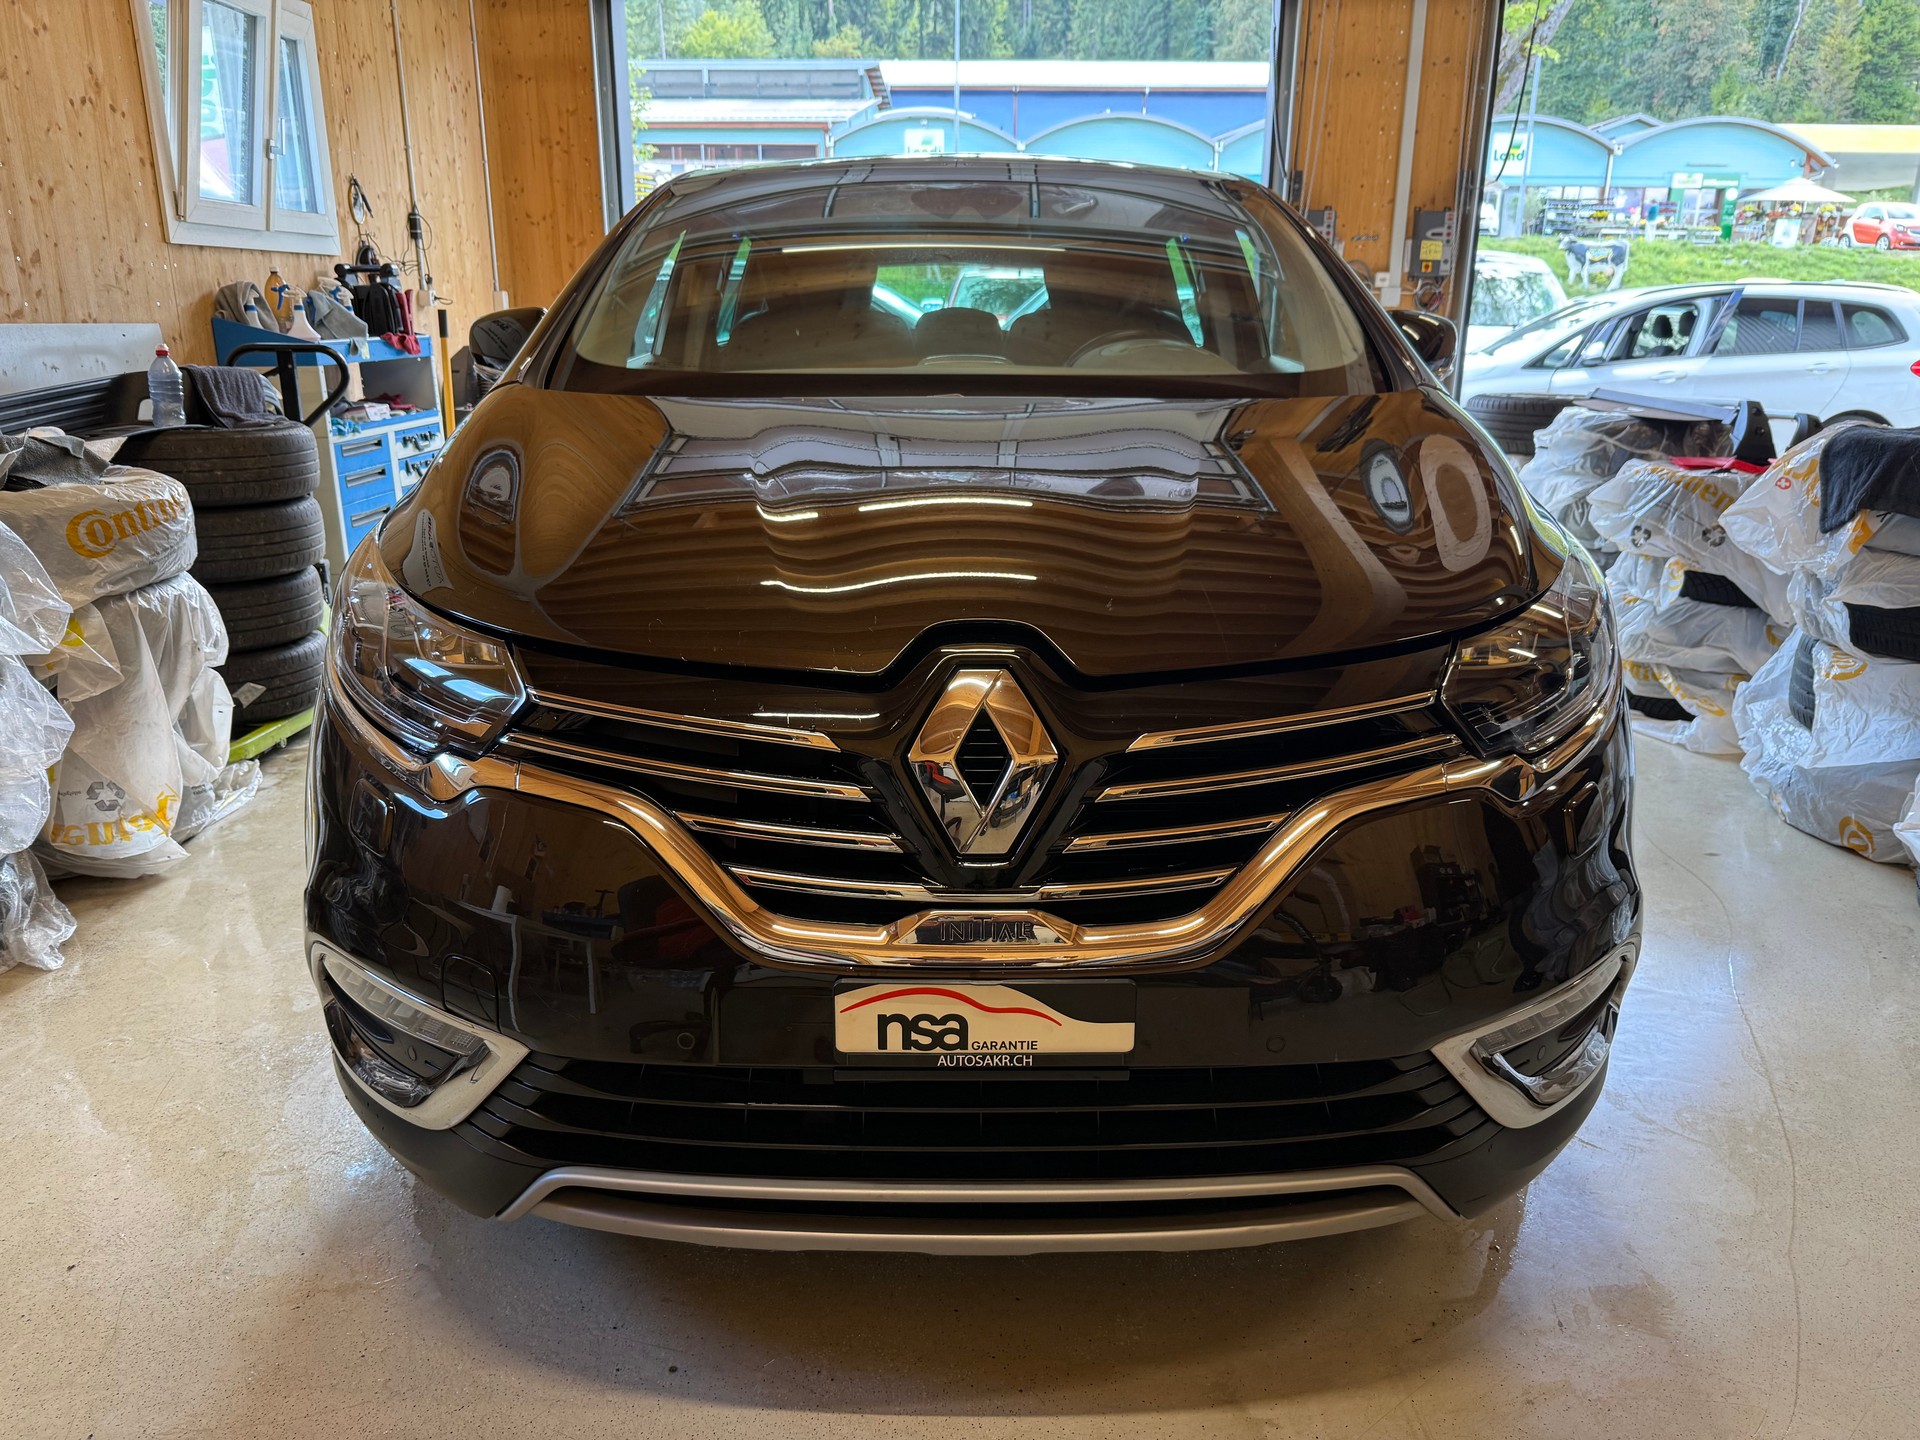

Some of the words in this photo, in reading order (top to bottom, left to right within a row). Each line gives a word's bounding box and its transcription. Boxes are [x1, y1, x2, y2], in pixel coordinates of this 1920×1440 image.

[940, 917, 1033, 942] INITIALE
[877, 1013, 969, 1051] nsa
[971, 1041, 1038, 1051] GARANTIE
[937, 1054, 1033, 1067] AUTOSAKR.CH
